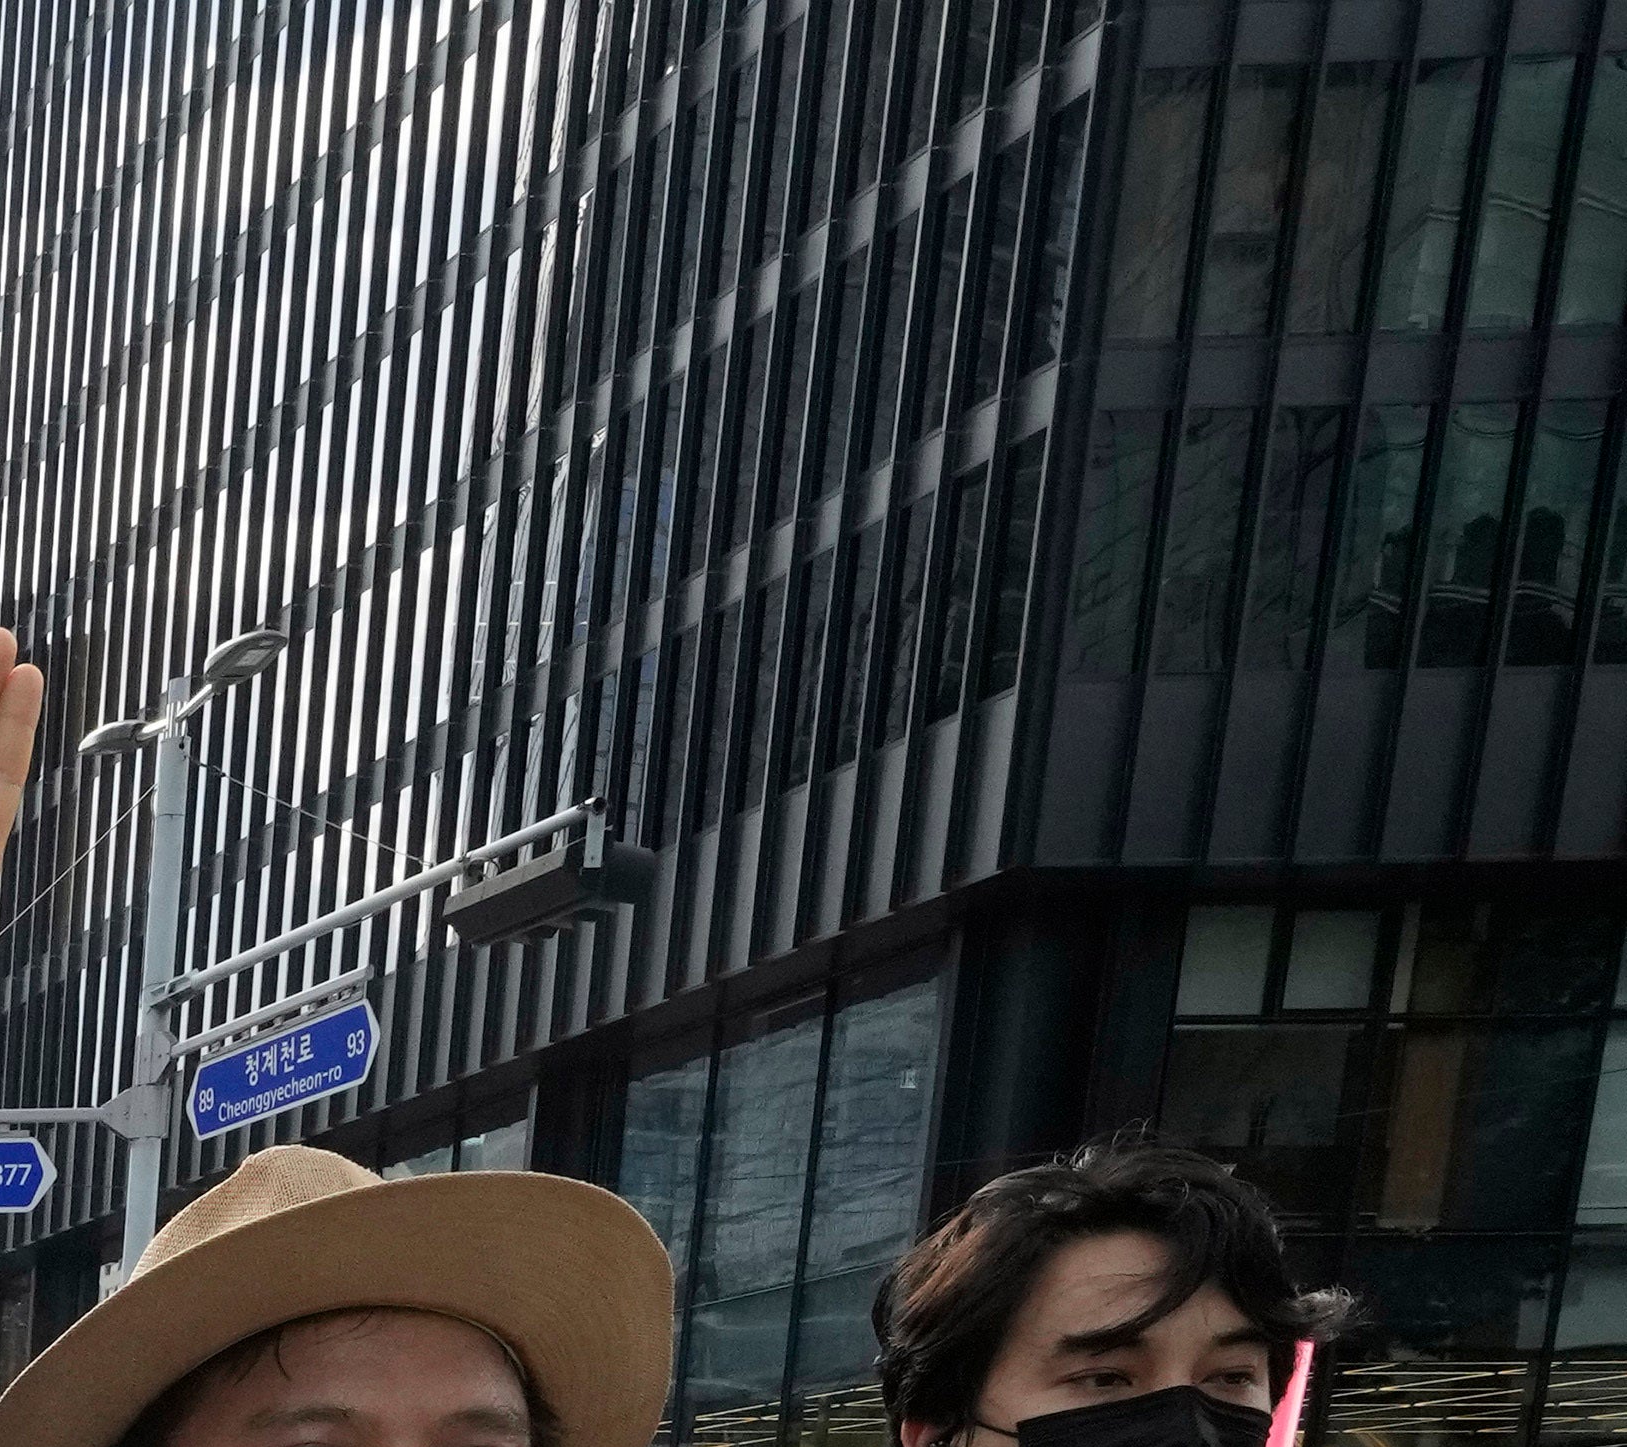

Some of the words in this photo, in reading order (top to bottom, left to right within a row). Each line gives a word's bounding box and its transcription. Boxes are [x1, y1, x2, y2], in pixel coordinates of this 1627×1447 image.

[198, 1087, 214, 1114] 89
[245, 1033, 315, 1087] 청계천로
[347, 1029, 366, 1059] 93
[218, 1064, 344, 1123] Cheonggyecheon-ro
